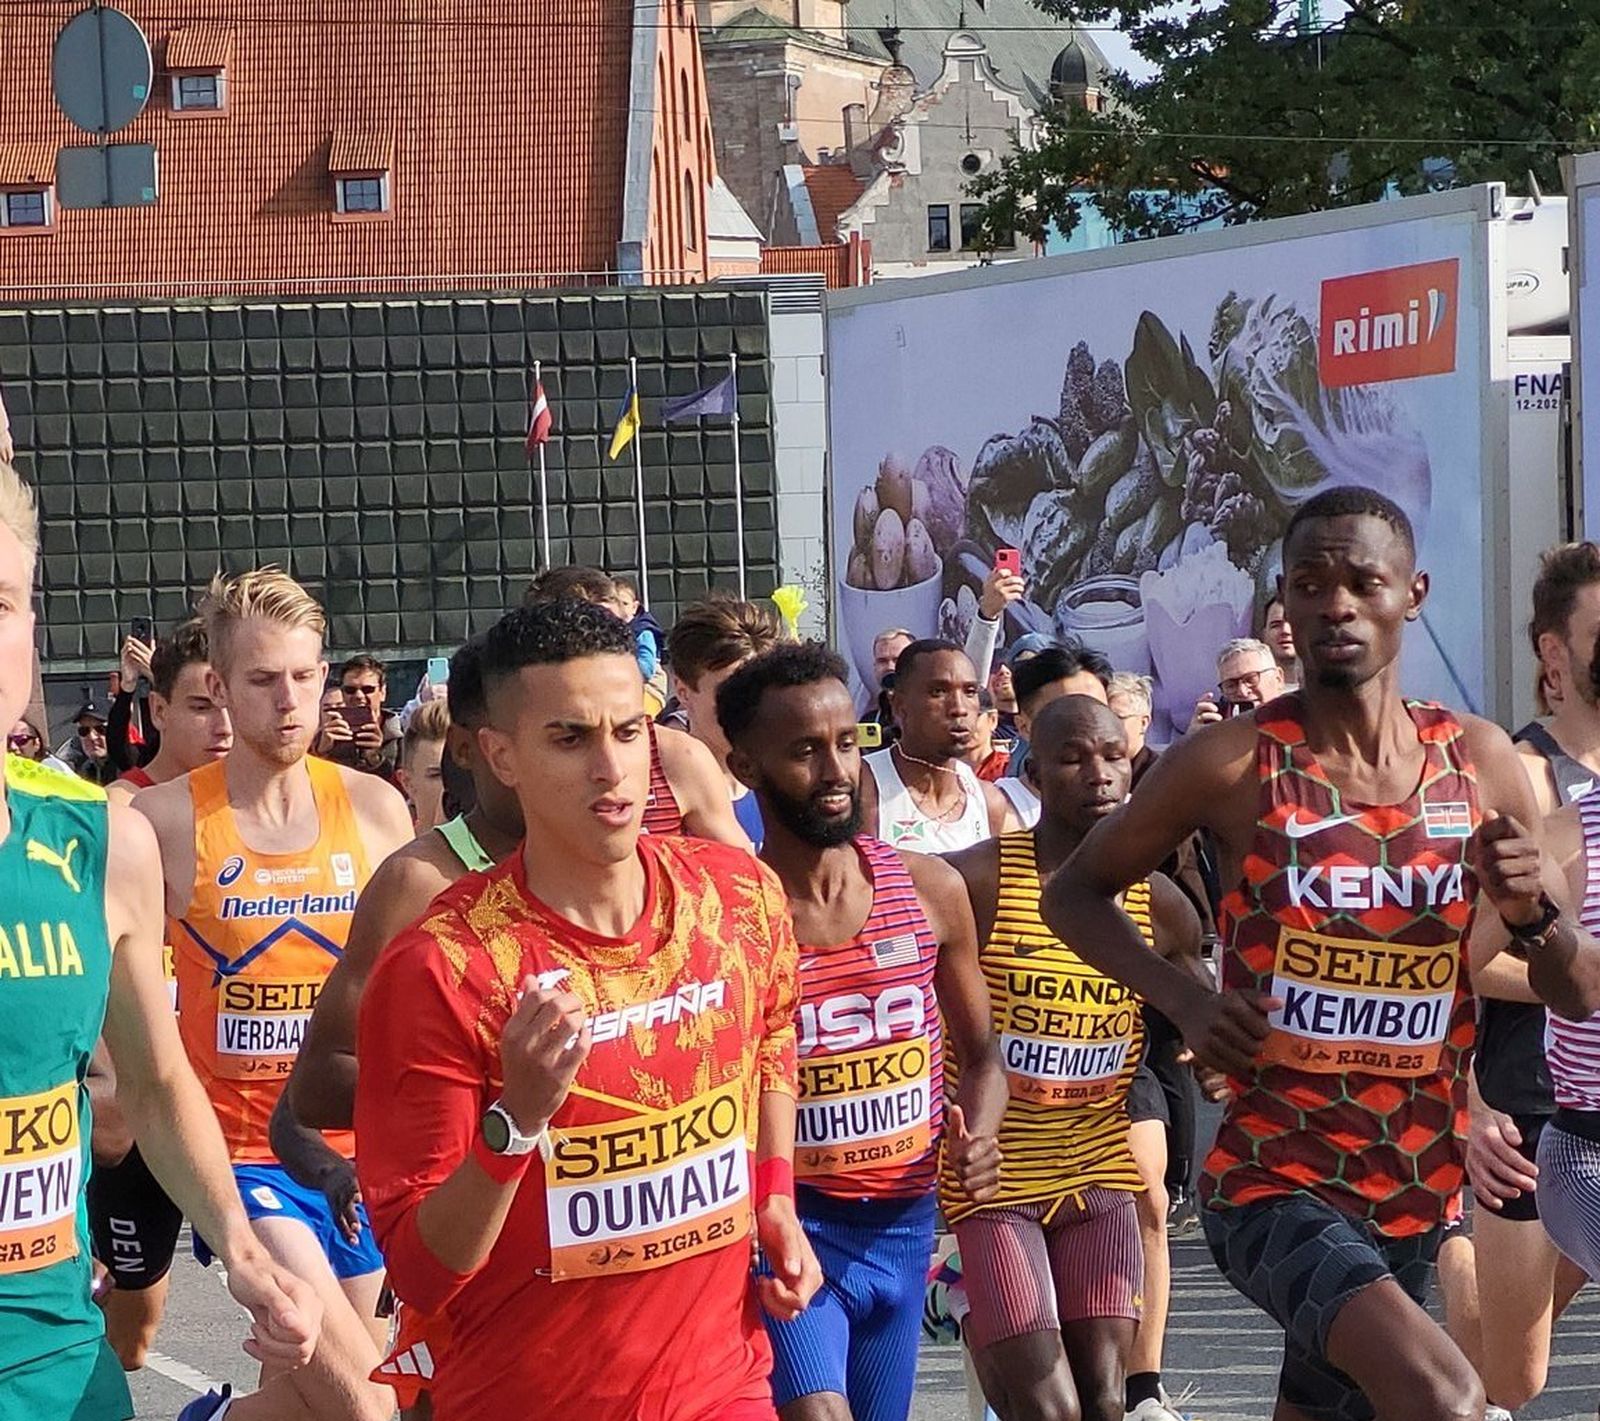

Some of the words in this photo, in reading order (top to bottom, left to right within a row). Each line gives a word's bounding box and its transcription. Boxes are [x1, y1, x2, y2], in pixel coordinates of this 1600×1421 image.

[1334, 299, 1419, 356] Rimi
[1287, 863, 1464, 909] KENYA
[1283, 938, 1455, 990] SEIKO
[224, 1018, 308, 1051] VERBAA
[1009, 1004, 1131, 1040] SEIKO
[1283, 986, 1442, 1040] KEMBOI
[798, 1047, 925, 1097] EIKO
[1007, 1039, 1125, 1076] CHEMUTAI
[1336, 1049, 1392, 1069] RIGA
[1395, 1054, 1424, 1070] 23
[0, 1097, 73, 1156] KO
[554, 1095, 738, 1180] SEIKO
[843, 1145, 893, 1165] RIGA
[895, 1136, 914, 1154] 23
[568, 1149, 739, 1237] OUMAIZ
[30, 1235, 57, 1258] 23
[109, 1217, 145, 1272] DEN
[642, 1229, 703, 1260] RIGA
[707, 1217, 735, 1241] 23
